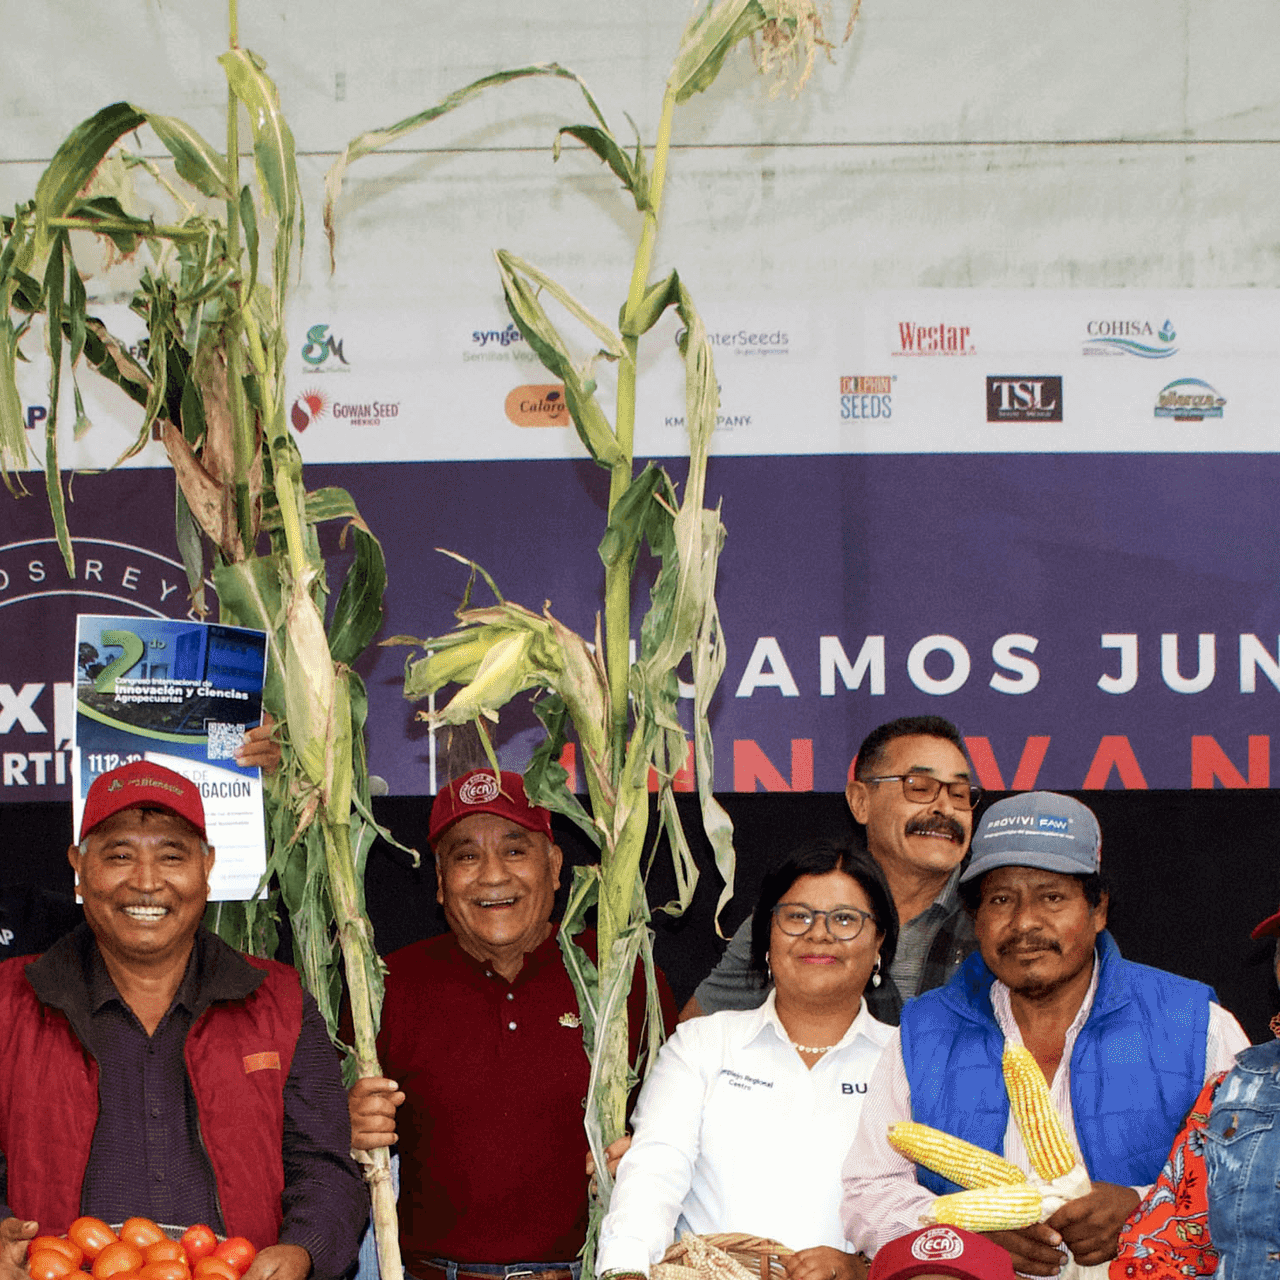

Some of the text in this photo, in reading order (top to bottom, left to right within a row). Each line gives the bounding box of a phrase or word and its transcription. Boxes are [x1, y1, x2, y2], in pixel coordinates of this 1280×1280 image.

[898, 322, 971, 350] Westar
[1087, 321, 1153, 336] COHISA
[992, 381, 1056, 411] TSL
[333, 402, 398, 418] GOWAN SEED
[840, 394, 892, 418] SEEDS
[115, 677, 151, 687] Congreso
[152, 678, 201, 688] Internacional
[114, 685, 183, 696] Innovación
[197, 687, 249, 700] Ciencias
[114, 694, 183, 704] Agropecuarias
[1039, 818, 1068, 830] FAW
[925, 1238, 951, 1251] ECA
